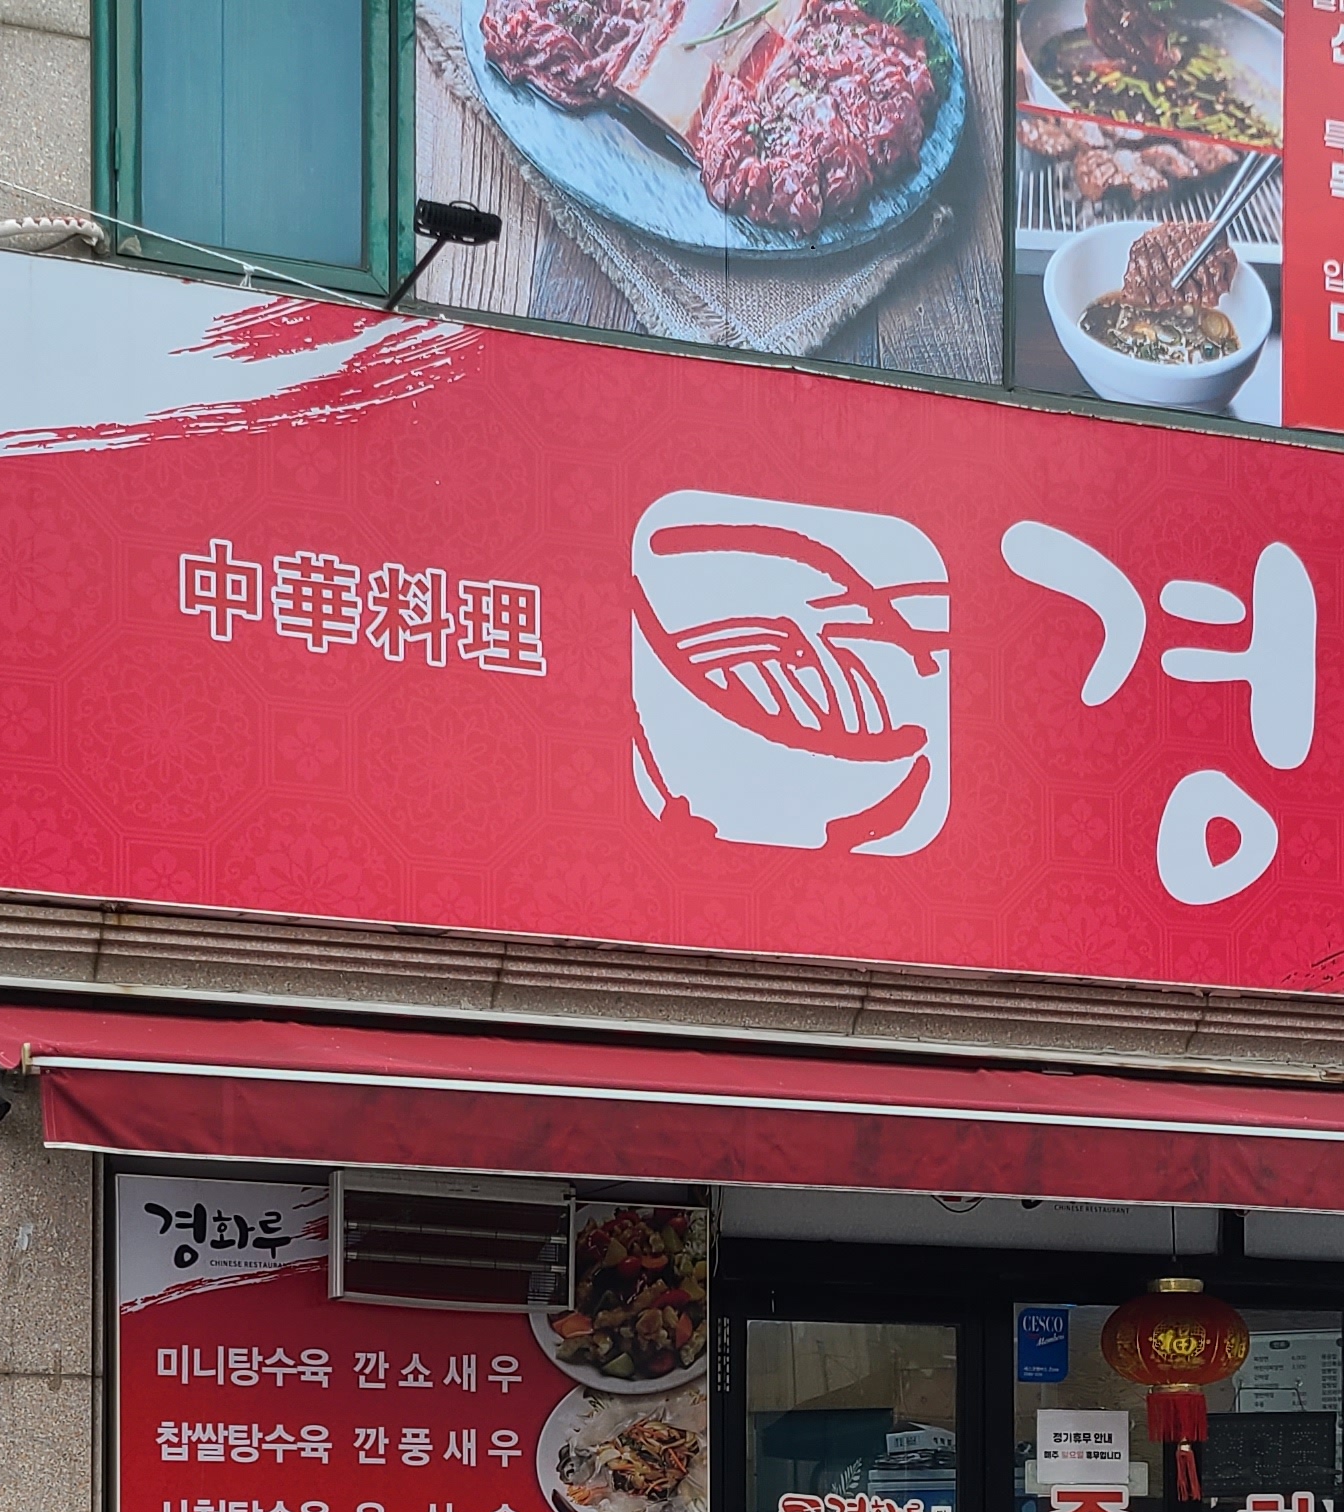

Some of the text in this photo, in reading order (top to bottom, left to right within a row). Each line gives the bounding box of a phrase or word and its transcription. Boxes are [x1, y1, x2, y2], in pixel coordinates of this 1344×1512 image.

[178, 539, 547, 678] 中華料理
[1054, 1204, 1130, 1214] CHINESE RESTAURANT
[144, 1203, 292, 1268] 경화루
[210, 1259, 242, 1268] CHINESE
[1022, 1315, 1064, 1333] CESCO
[156, 1345, 524, 1394] 미니탕수육 깐쇼새우
[155, 1421, 524, 1468] 찹쌀탕수육 깐풍새우
[1053, 1432, 1113, 1444] 정기휴무 안내
